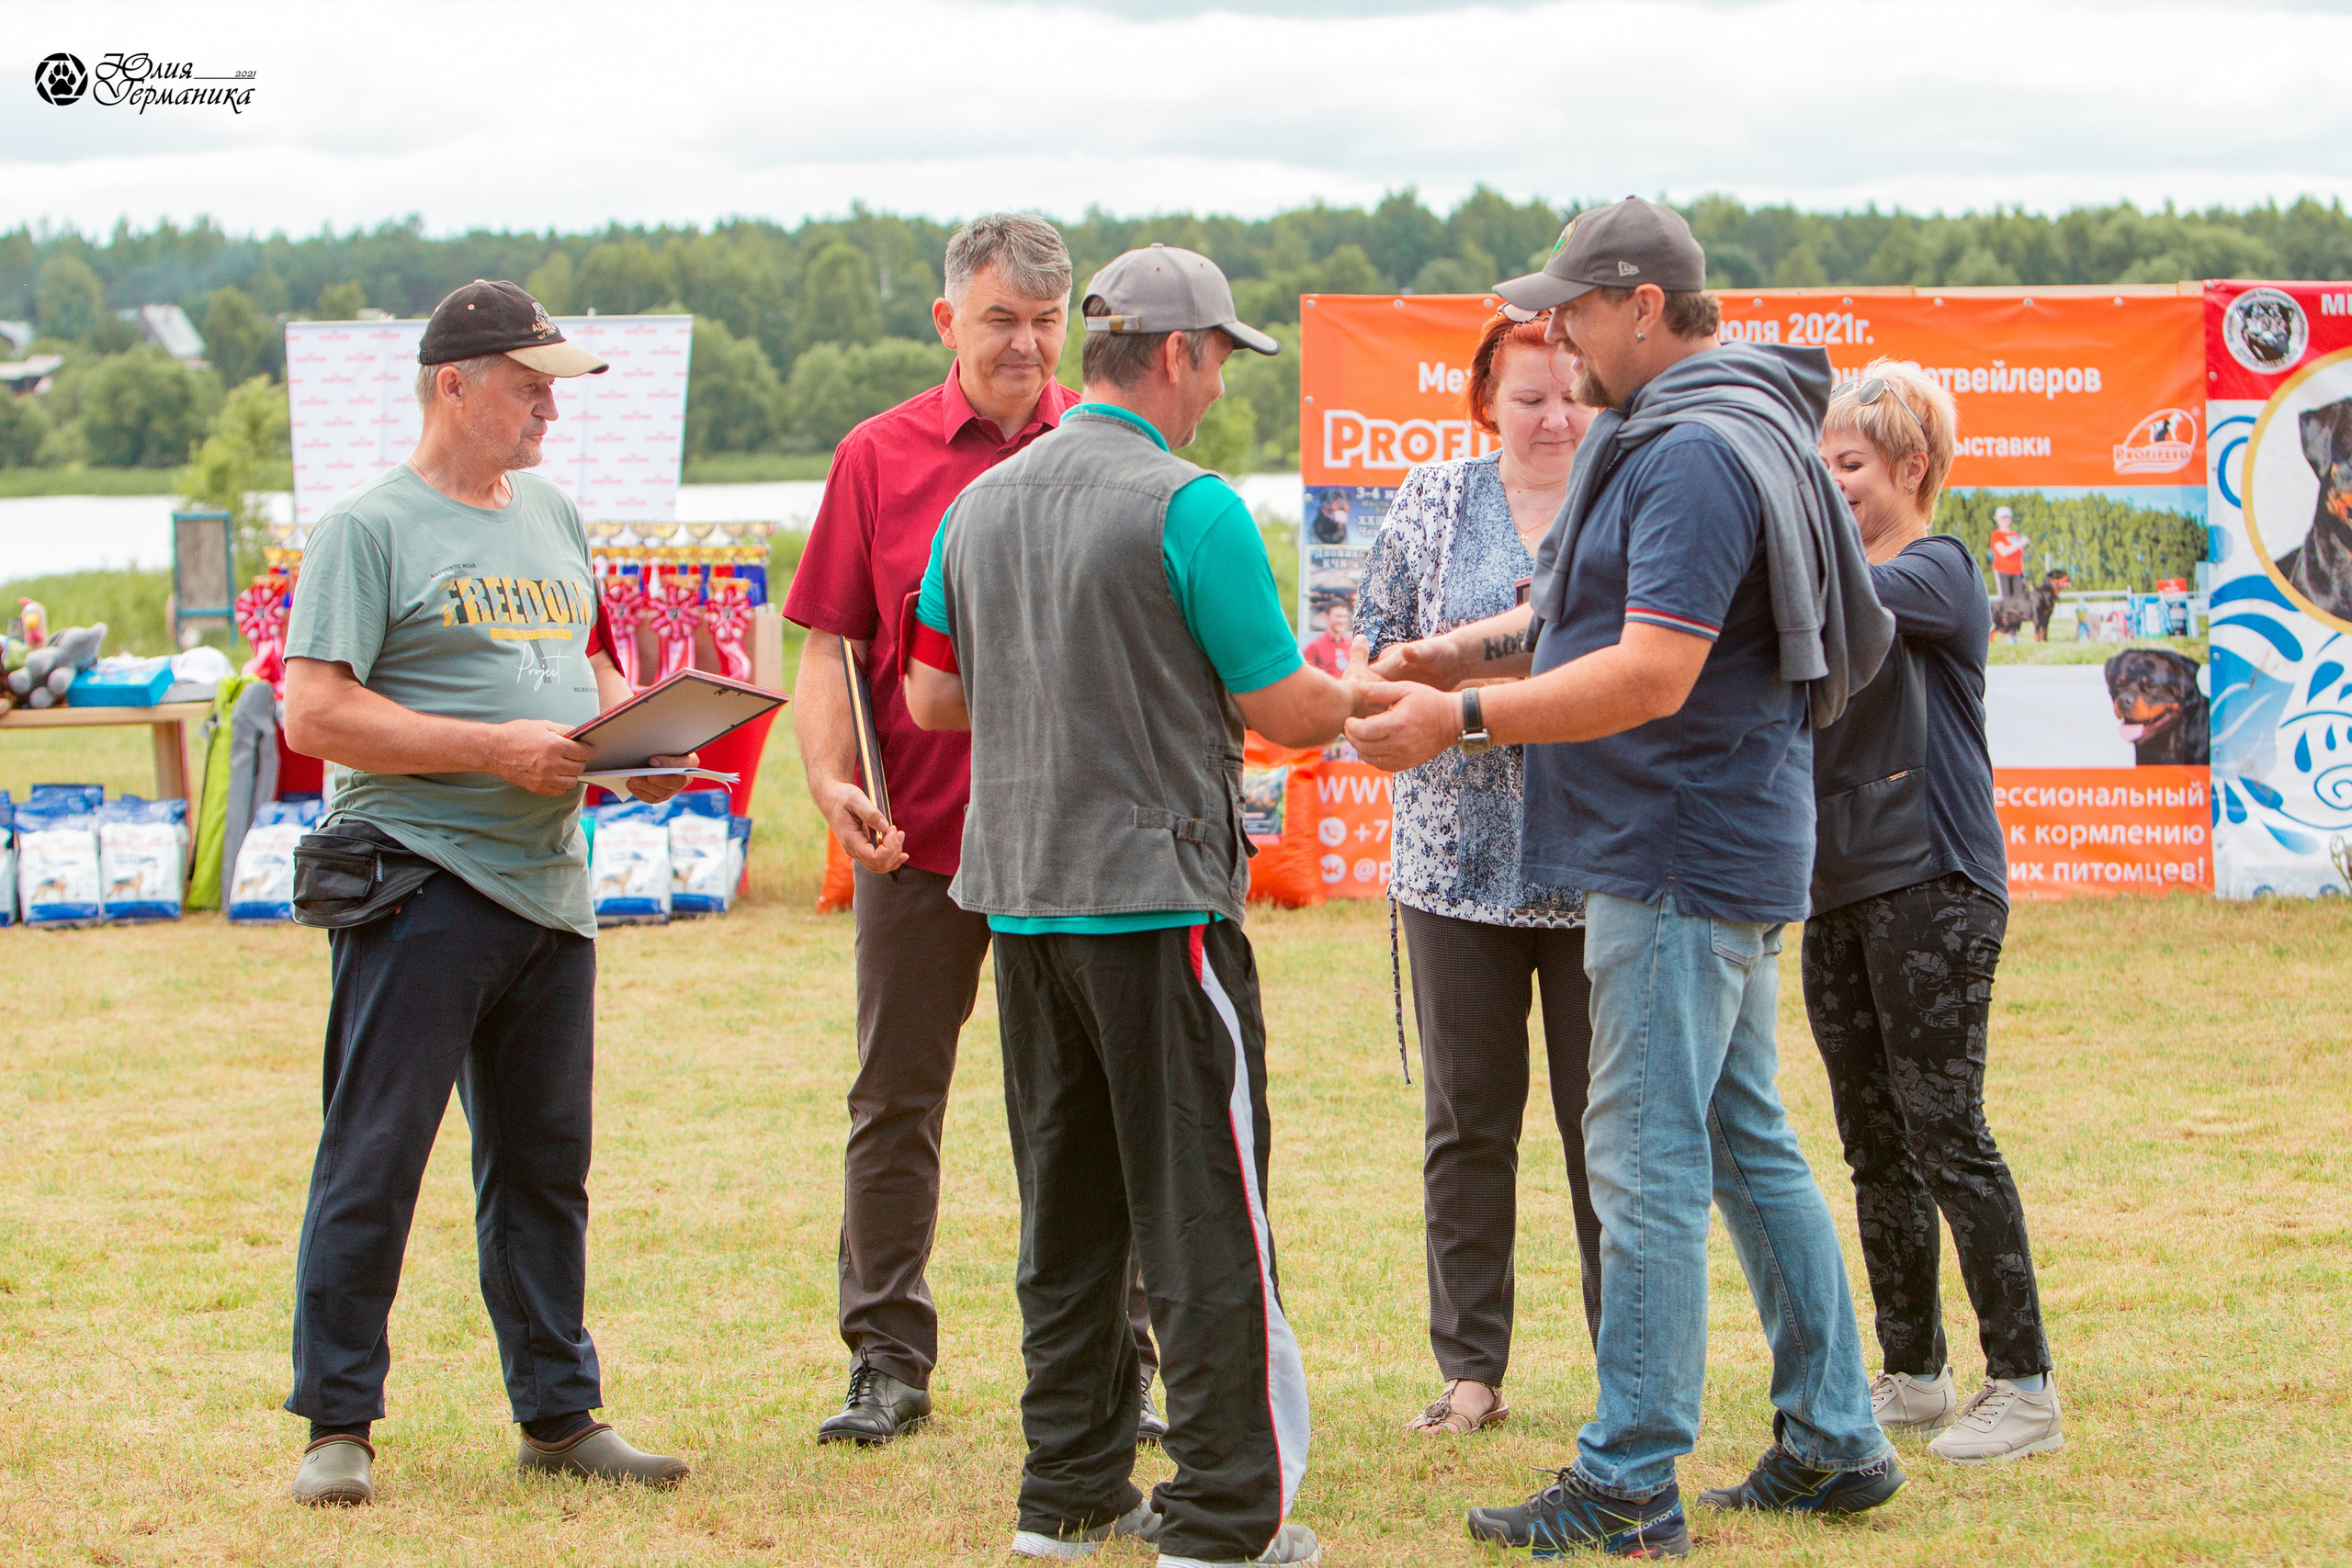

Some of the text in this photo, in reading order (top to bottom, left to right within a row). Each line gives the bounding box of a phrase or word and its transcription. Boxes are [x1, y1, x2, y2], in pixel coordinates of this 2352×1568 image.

[1719, 312, 1875, 344] юля 2021г.
[1900, 360, 2102, 400] отвейлеров
[1954, 436, 2052, 457] ыставки
[2114, 446, 2192, 462] PROFIFEED
[430, 563, 462, 580] AUTHENTIC
[443, 576, 591, 626] FREEDOM
[514, 642, 571, 693] Project
[1993, 781, 2204, 807] ессиональный
[2010, 824, 2205, 852] к кормлению
[1353, 858, 1393, 886] @p
[2053, 857, 2205, 886] питомцев!
